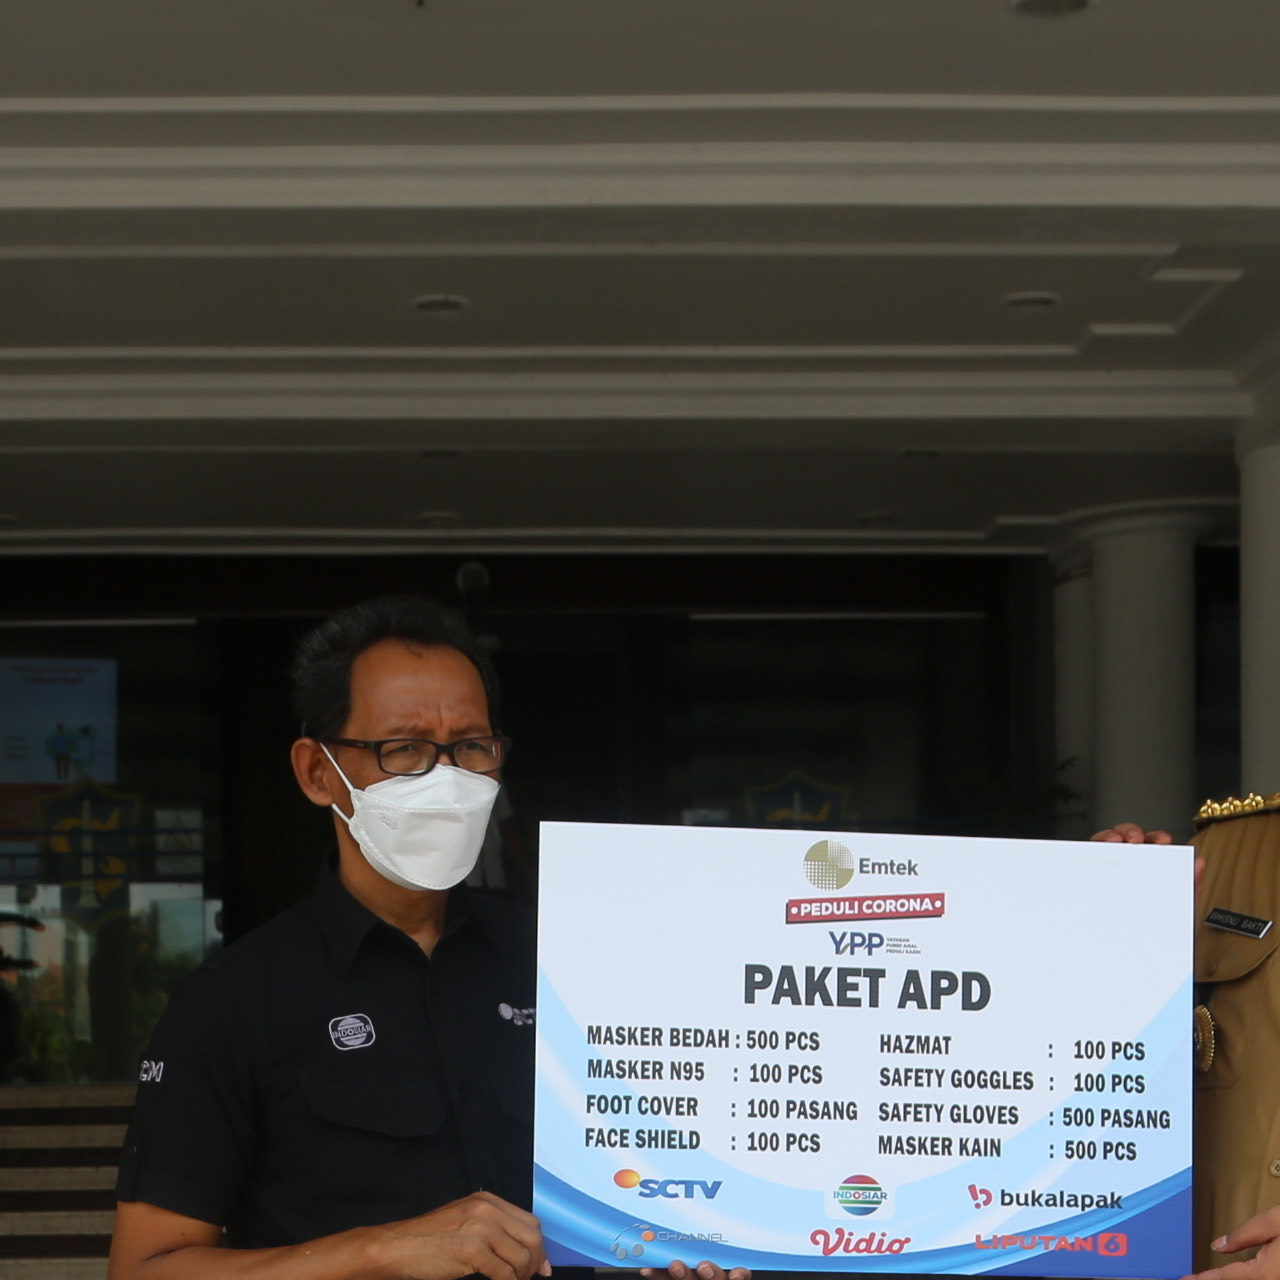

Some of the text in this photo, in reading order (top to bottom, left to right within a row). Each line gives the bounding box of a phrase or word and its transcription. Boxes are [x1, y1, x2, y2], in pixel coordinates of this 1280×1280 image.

[859, 858, 919, 877] Emtek
[799, 897, 933, 918] PEDULI CORONA
[829, 931, 884, 956] YPP
[745, 964, 991, 1011] PAKET APD
[333, 1023, 373, 1039] INDOSIAR
[587, 1026, 821, 1051] MASKER BEDAH 500 PCS
[880, 1034, 1146, 1062] HAZMAT 100 PCS
[587, 1060, 823, 1086] MASKER N95 100 PCS
[879, 1068, 1146, 1094] SAFETY GOGGLES 100 PCS
[586, 1095, 858, 1121] FOOT COVER 100 PASANG
[879, 1103, 1171, 1130] SAFETY GLOVES 500 PASANG
[585, 1129, 821, 1153] FACE SHIELD 100 PCS
[878, 1136, 1137, 1162] MASKER KAIN 500 PCS
[639, 1180, 723, 1200] SCTV
[833, 1190, 888, 1201] INDOSIAR
[1000, 1188, 1123, 1211] bukalapak
[657, 1231, 728, 1244] CHANNEL
[810, 1227, 912, 1256] Vidio
[975, 1235, 1093, 1252] LIPUTAN
